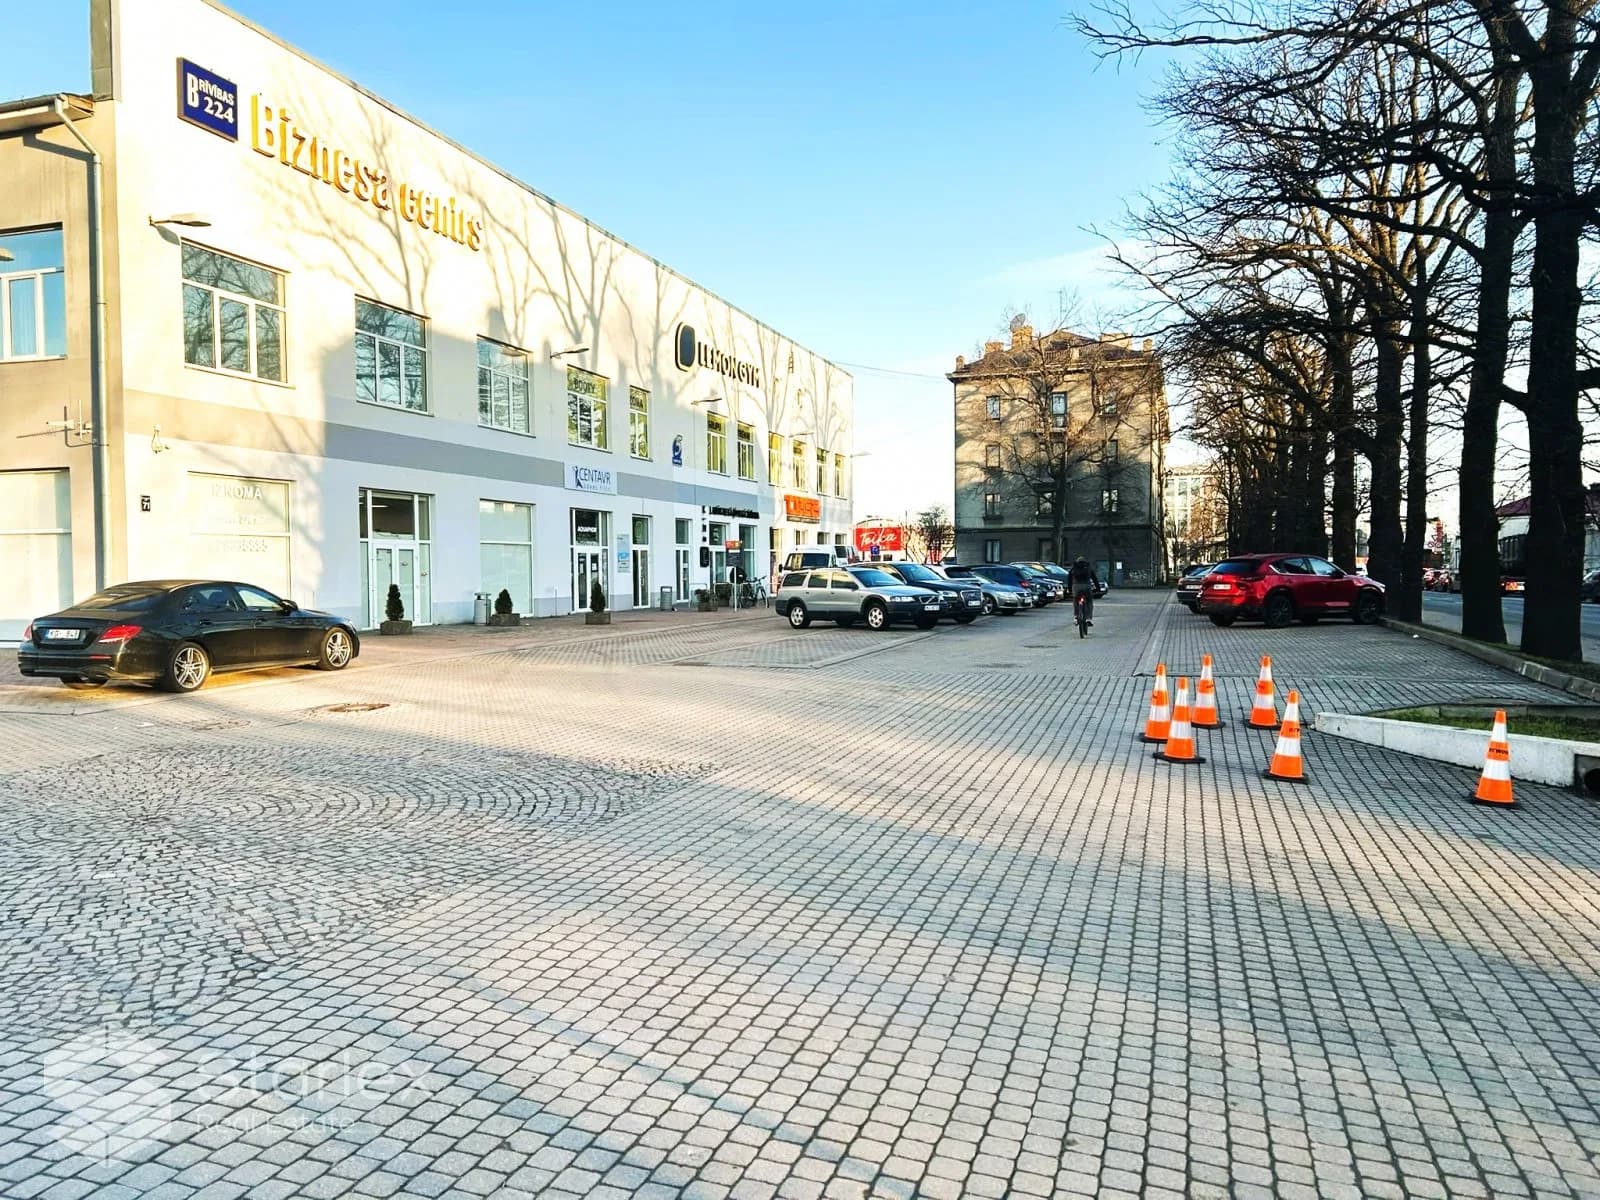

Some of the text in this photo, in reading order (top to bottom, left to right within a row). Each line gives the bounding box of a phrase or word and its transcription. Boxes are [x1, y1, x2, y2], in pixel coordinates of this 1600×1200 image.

[204, 97, 234, 124] 224
[251, 93, 392, 210] Biznesa
[860, 528, 898, 547] Teika
